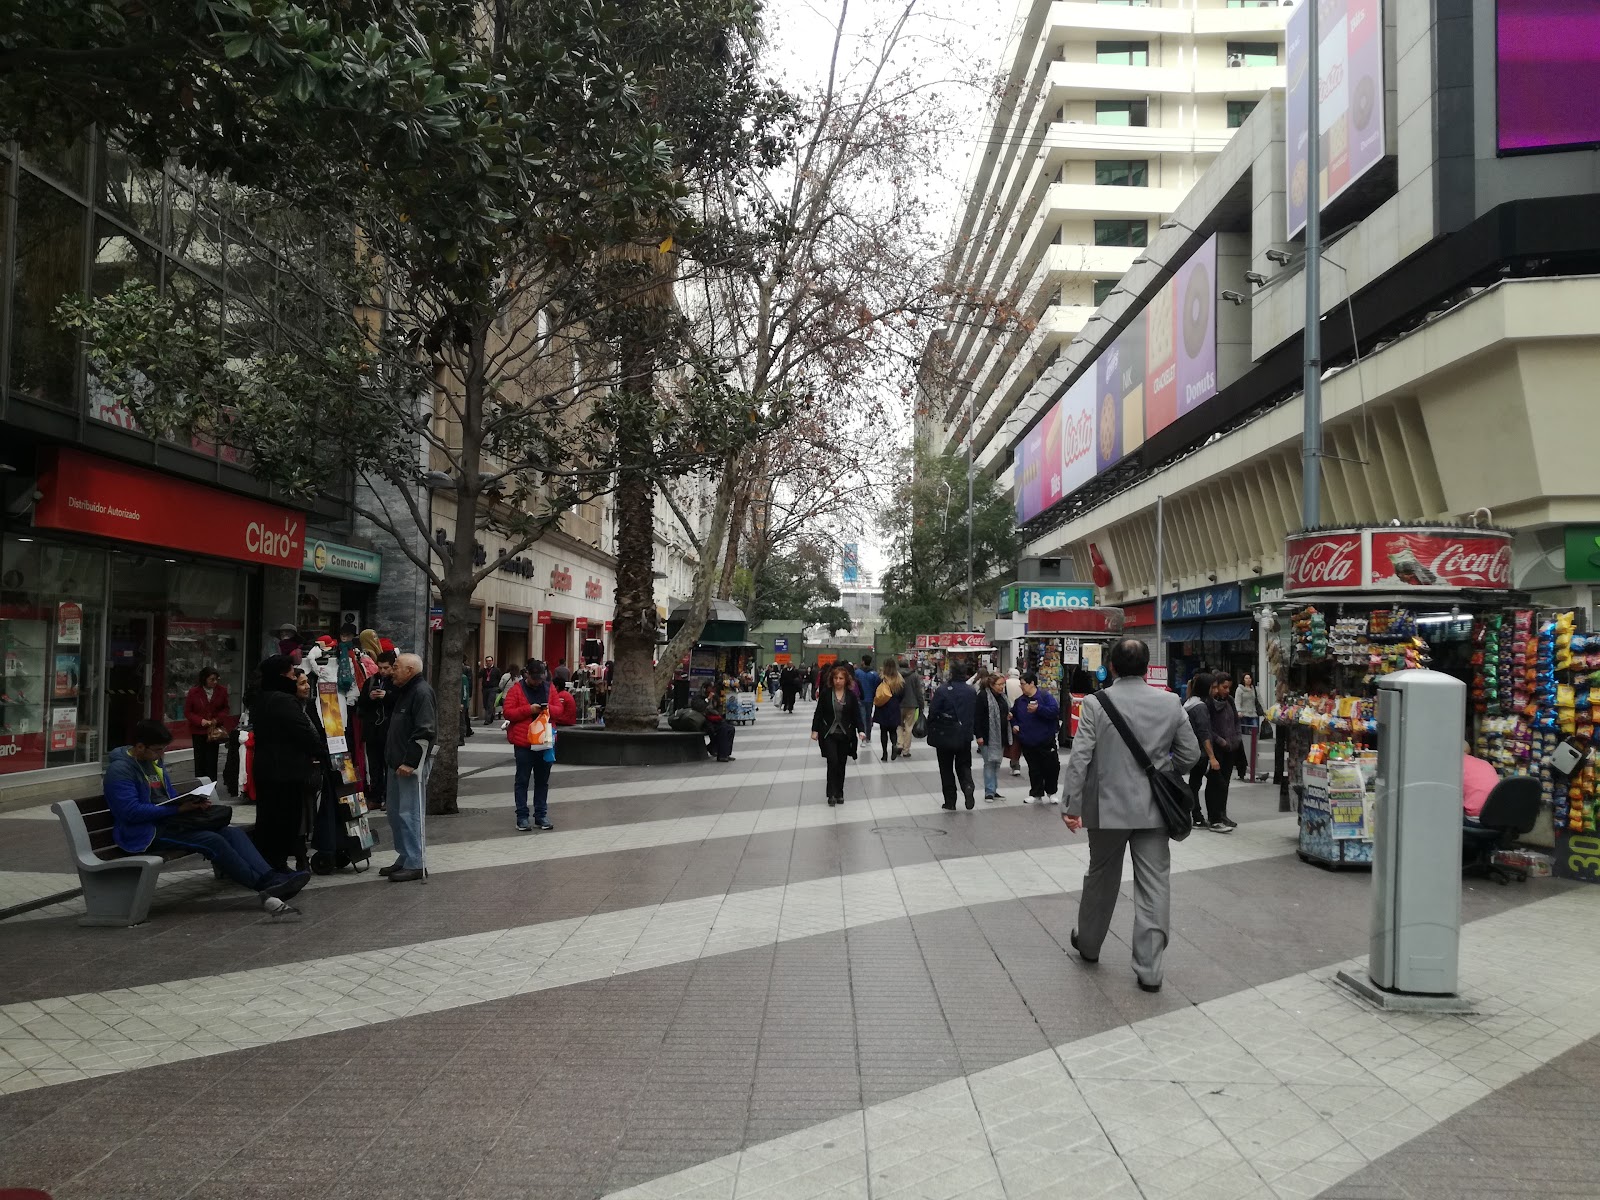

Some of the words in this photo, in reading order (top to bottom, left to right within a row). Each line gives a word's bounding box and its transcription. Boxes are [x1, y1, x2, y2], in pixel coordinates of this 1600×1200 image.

[1319, 63, 1345, 105] osta
[1185, 372, 1215, 405] Donuts
[1063, 408, 1093, 468] Costa
[68, 496, 107, 514] Distribuidor
[107, 505, 140, 521] Autorizado
[245, 521, 291, 558] Claro
[330, 554, 367, 571] Comercial
[1030, 591, 1090, 608] Baños
